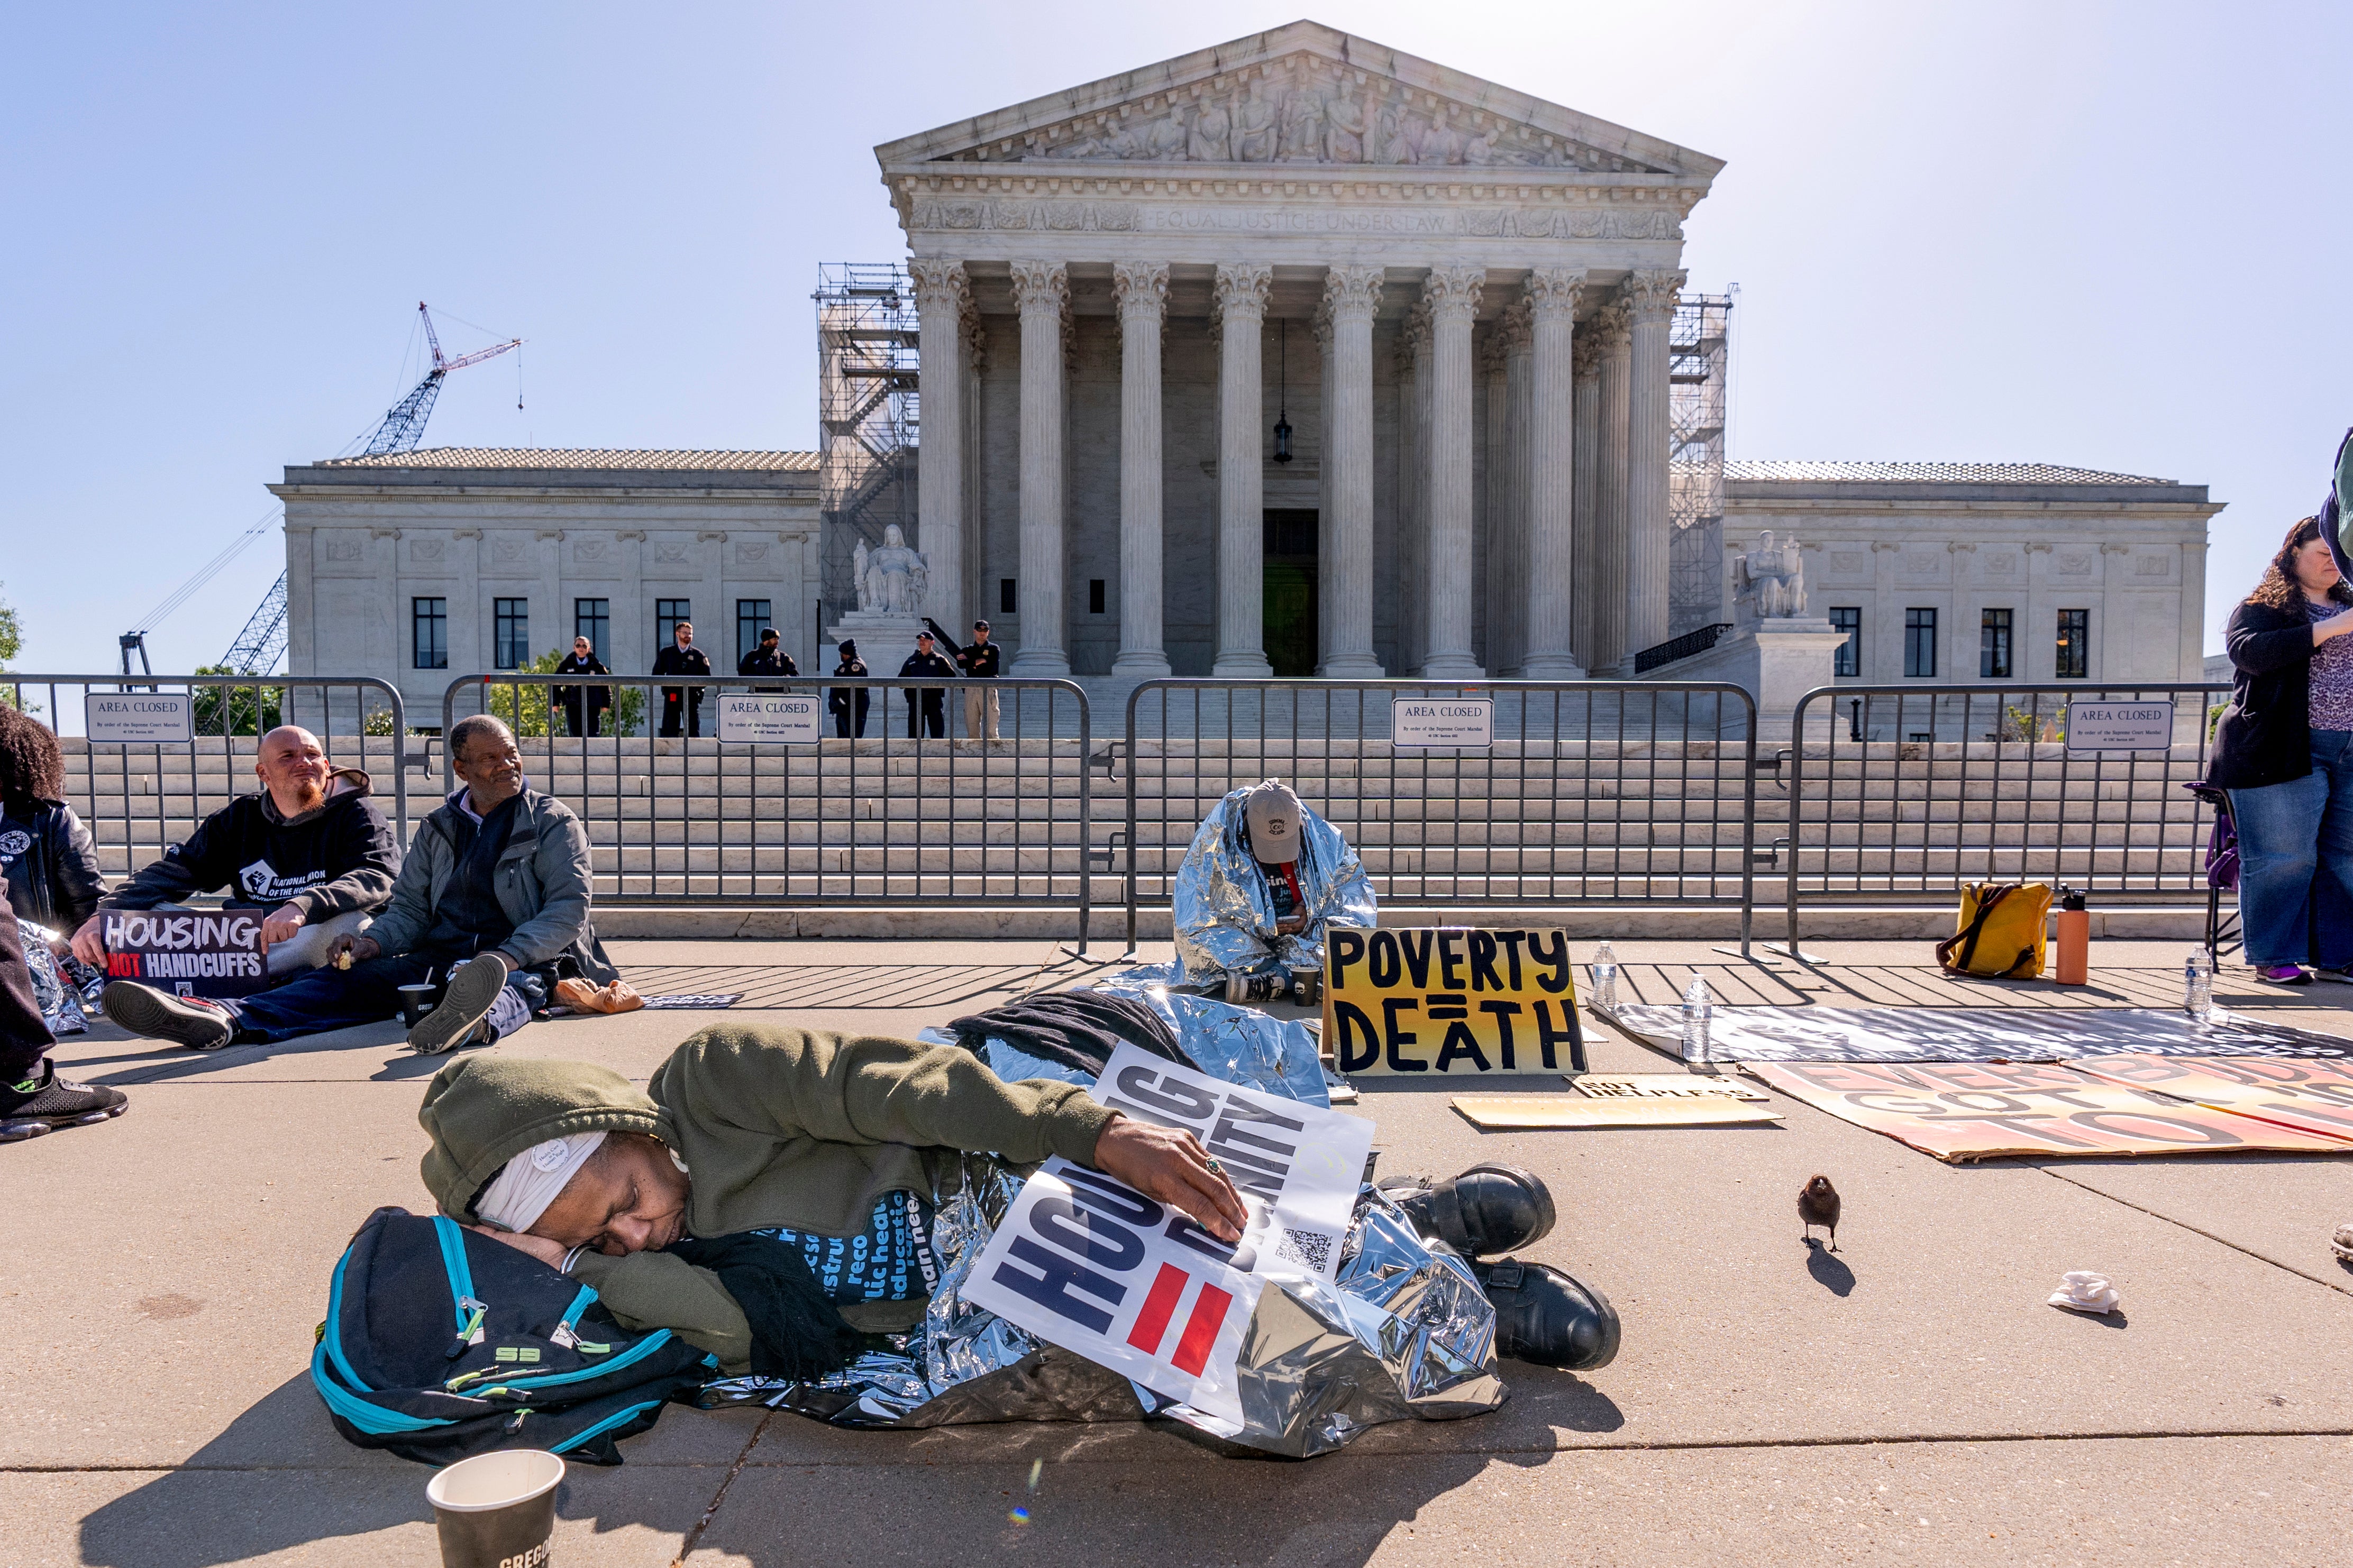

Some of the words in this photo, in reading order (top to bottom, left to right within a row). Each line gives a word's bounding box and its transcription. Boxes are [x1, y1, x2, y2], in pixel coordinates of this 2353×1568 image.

[1155, 211, 1228, 228] EQUAL
[1233, 212, 1315, 230] JUSTICE
[1326, 213, 1397, 231] UNDER
[1404, 214, 1446, 231] LAW
[98, 702, 129, 712] AREA
[133, 702, 178, 713] CLOSED
[730, 703, 761, 712] AREA
[765, 703, 809, 713] CLOSED
[1405, 707, 1435, 717] AREA
[1440, 707, 1482, 717] CLOSED
[2080, 711, 2112, 720] AREA
[2118, 710, 2162, 720] CLOSED
[273, 875, 306, 887] NATIONAL
[280, 887, 292, 896] THE
[105, 915, 262, 950] HOUSING
[107, 952, 140, 977] NOT
[145, 952, 262, 978] HANDCUFFS
[1329, 930, 1571, 994] POVERTY
[1333, 997, 1589, 1073] DEATH
[1885, 1031, 2130, 1042] NATIONAL
[2121, 1032, 2297, 1043] UNION
[2083, 1043, 2345, 1056] HOMELESS
[1590, 1089, 1754, 1098] HELPLESS
[1843, 1087, 2106, 1114] GOT
[1917, 1111, 2244, 1148] TO
[539, 1151, 551, 1161] Health
[542, 1157, 557, 1168] Human
[991, 1063, 1220, 1336] HOUG
